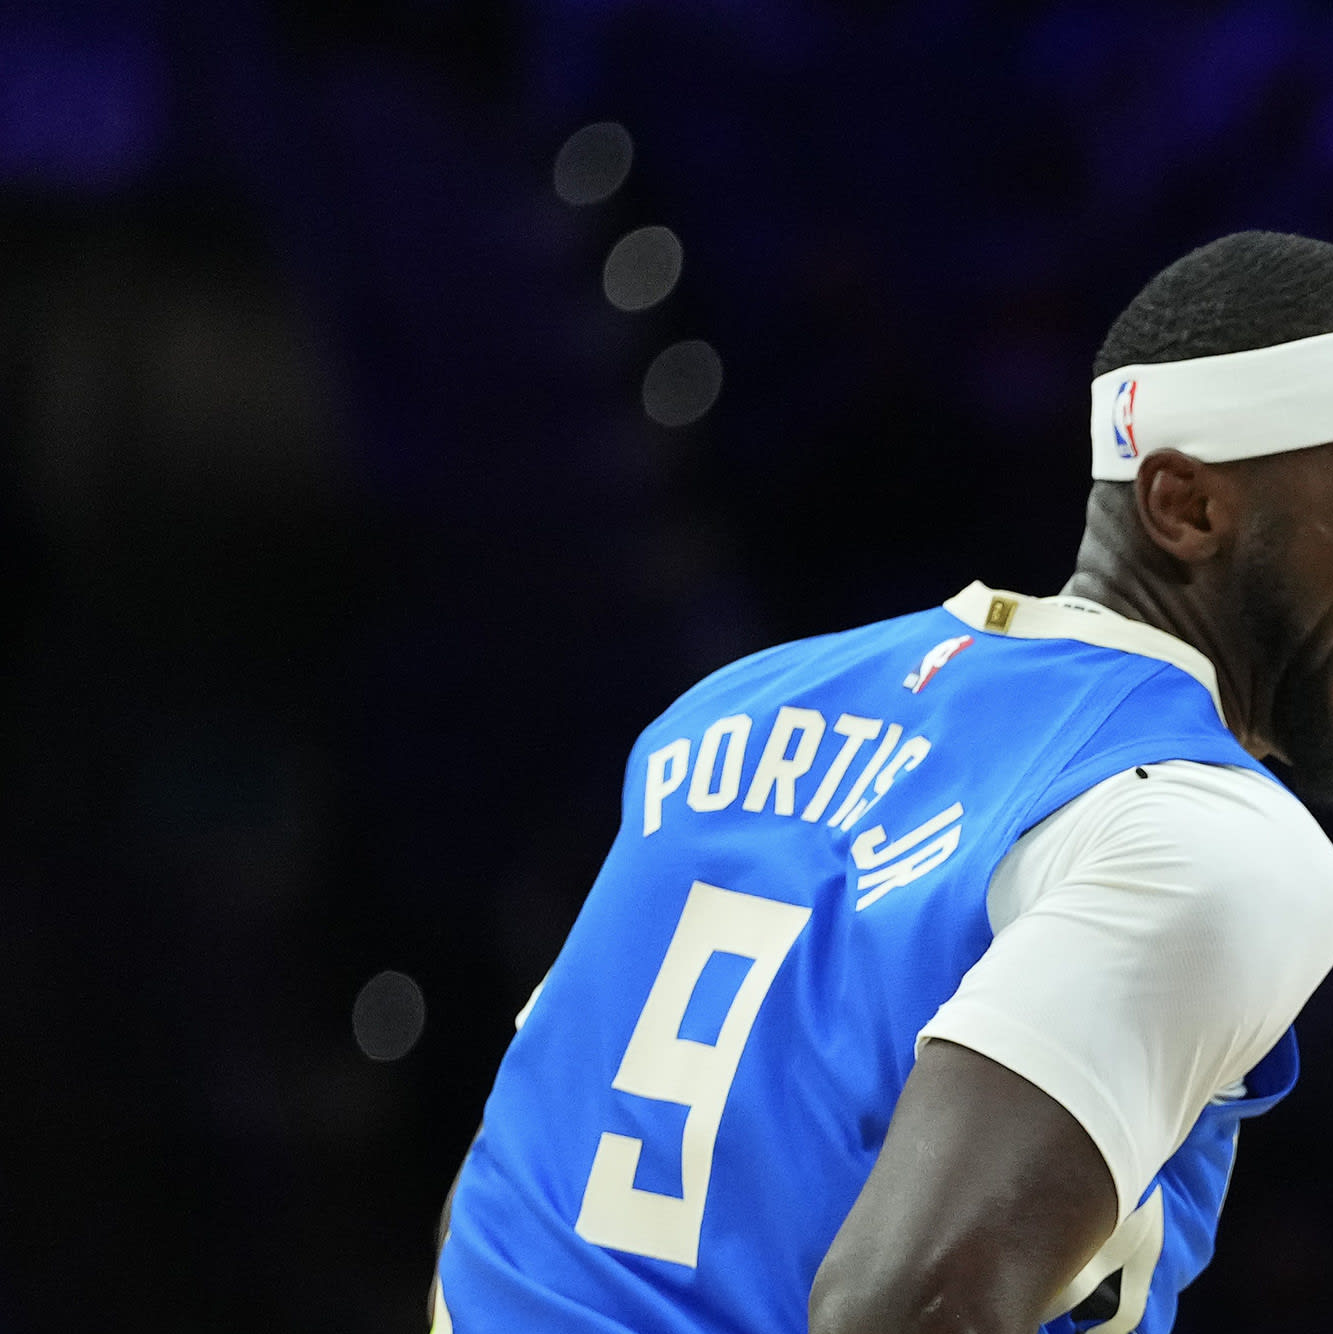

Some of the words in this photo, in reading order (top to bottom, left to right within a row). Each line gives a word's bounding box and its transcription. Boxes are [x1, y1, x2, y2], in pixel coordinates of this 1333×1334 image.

[643, 705, 932, 837] PORTIS
[850, 801, 965, 912] JR
[574, 879, 814, 1269] 9
